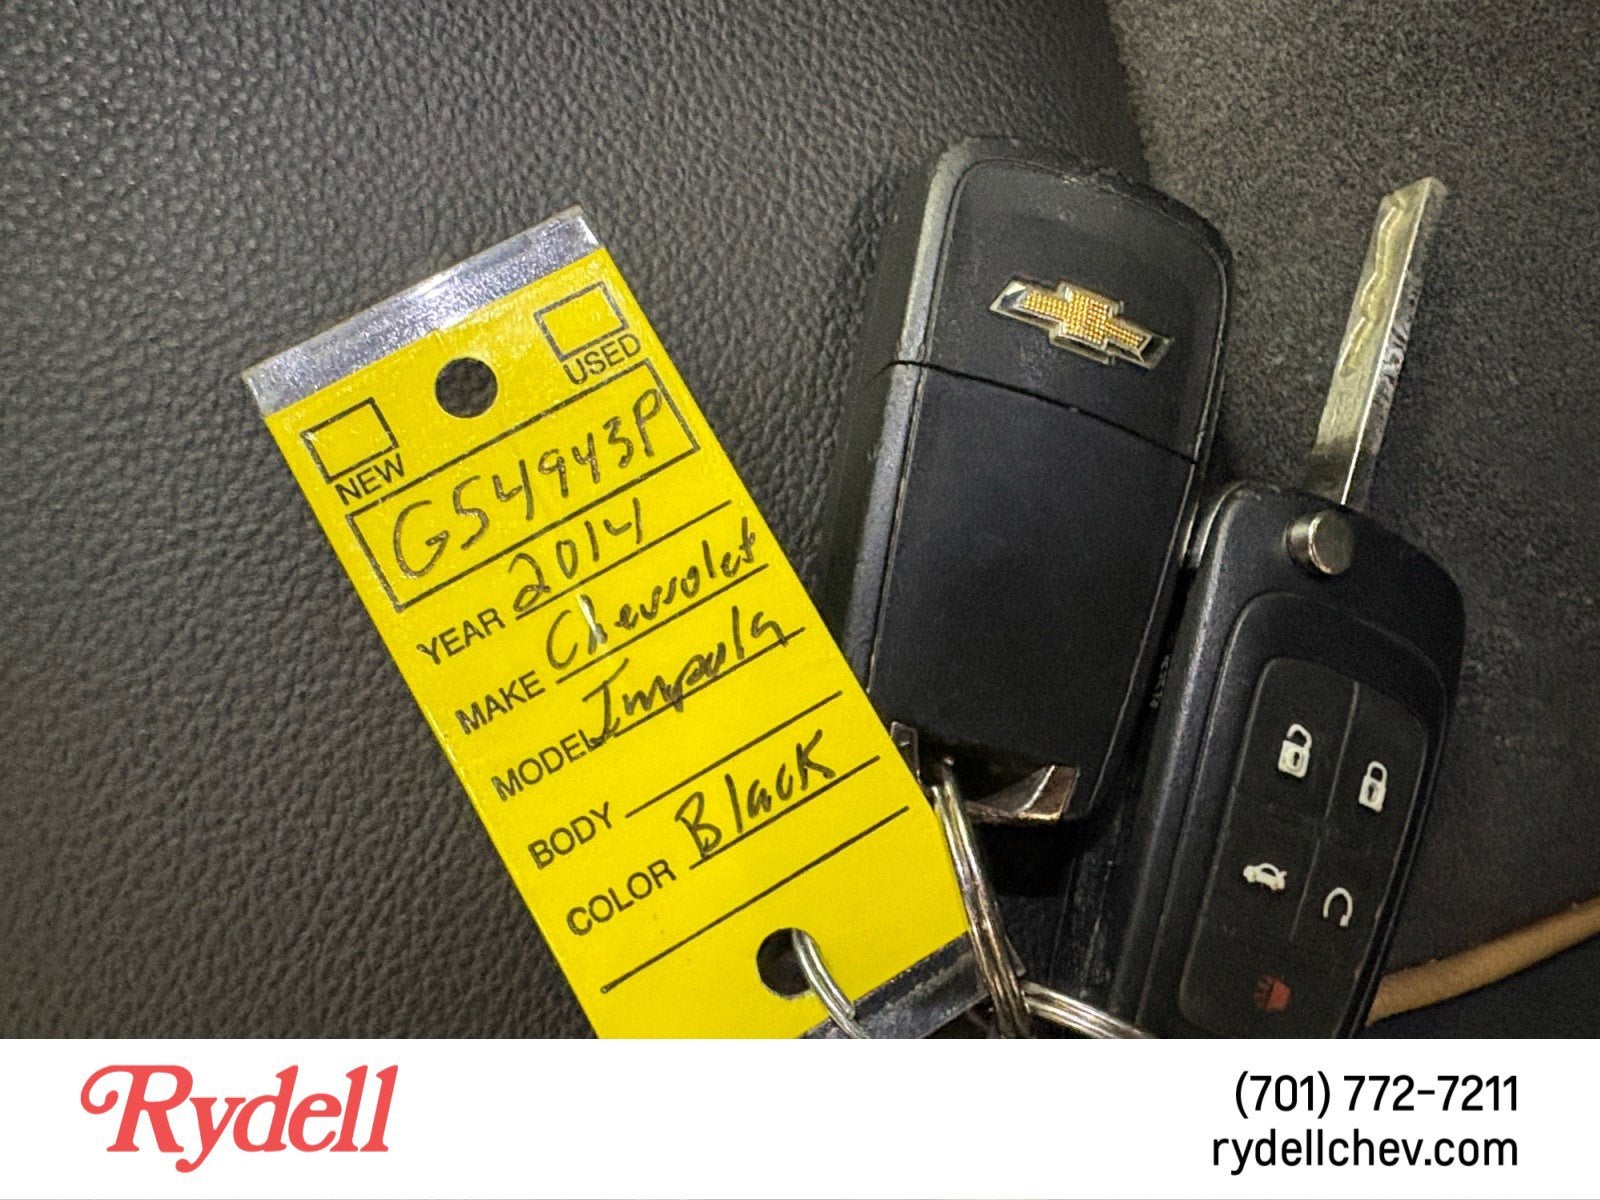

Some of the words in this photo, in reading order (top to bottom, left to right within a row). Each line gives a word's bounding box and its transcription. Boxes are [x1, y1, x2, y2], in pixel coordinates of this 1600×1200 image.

[564, 333, 642, 384] USED
[335, 454, 406, 505] NEW
[508, 497, 643, 613] 2014
[416, 608, 507, 666] YEAR
[455, 670, 546, 734] MAKE
[490, 727, 600, 802] MODEL
[674, 730, 836, 858] Black
[527, 801, 614, 870] BODY
[566, 859, 678, 937] COLOR
